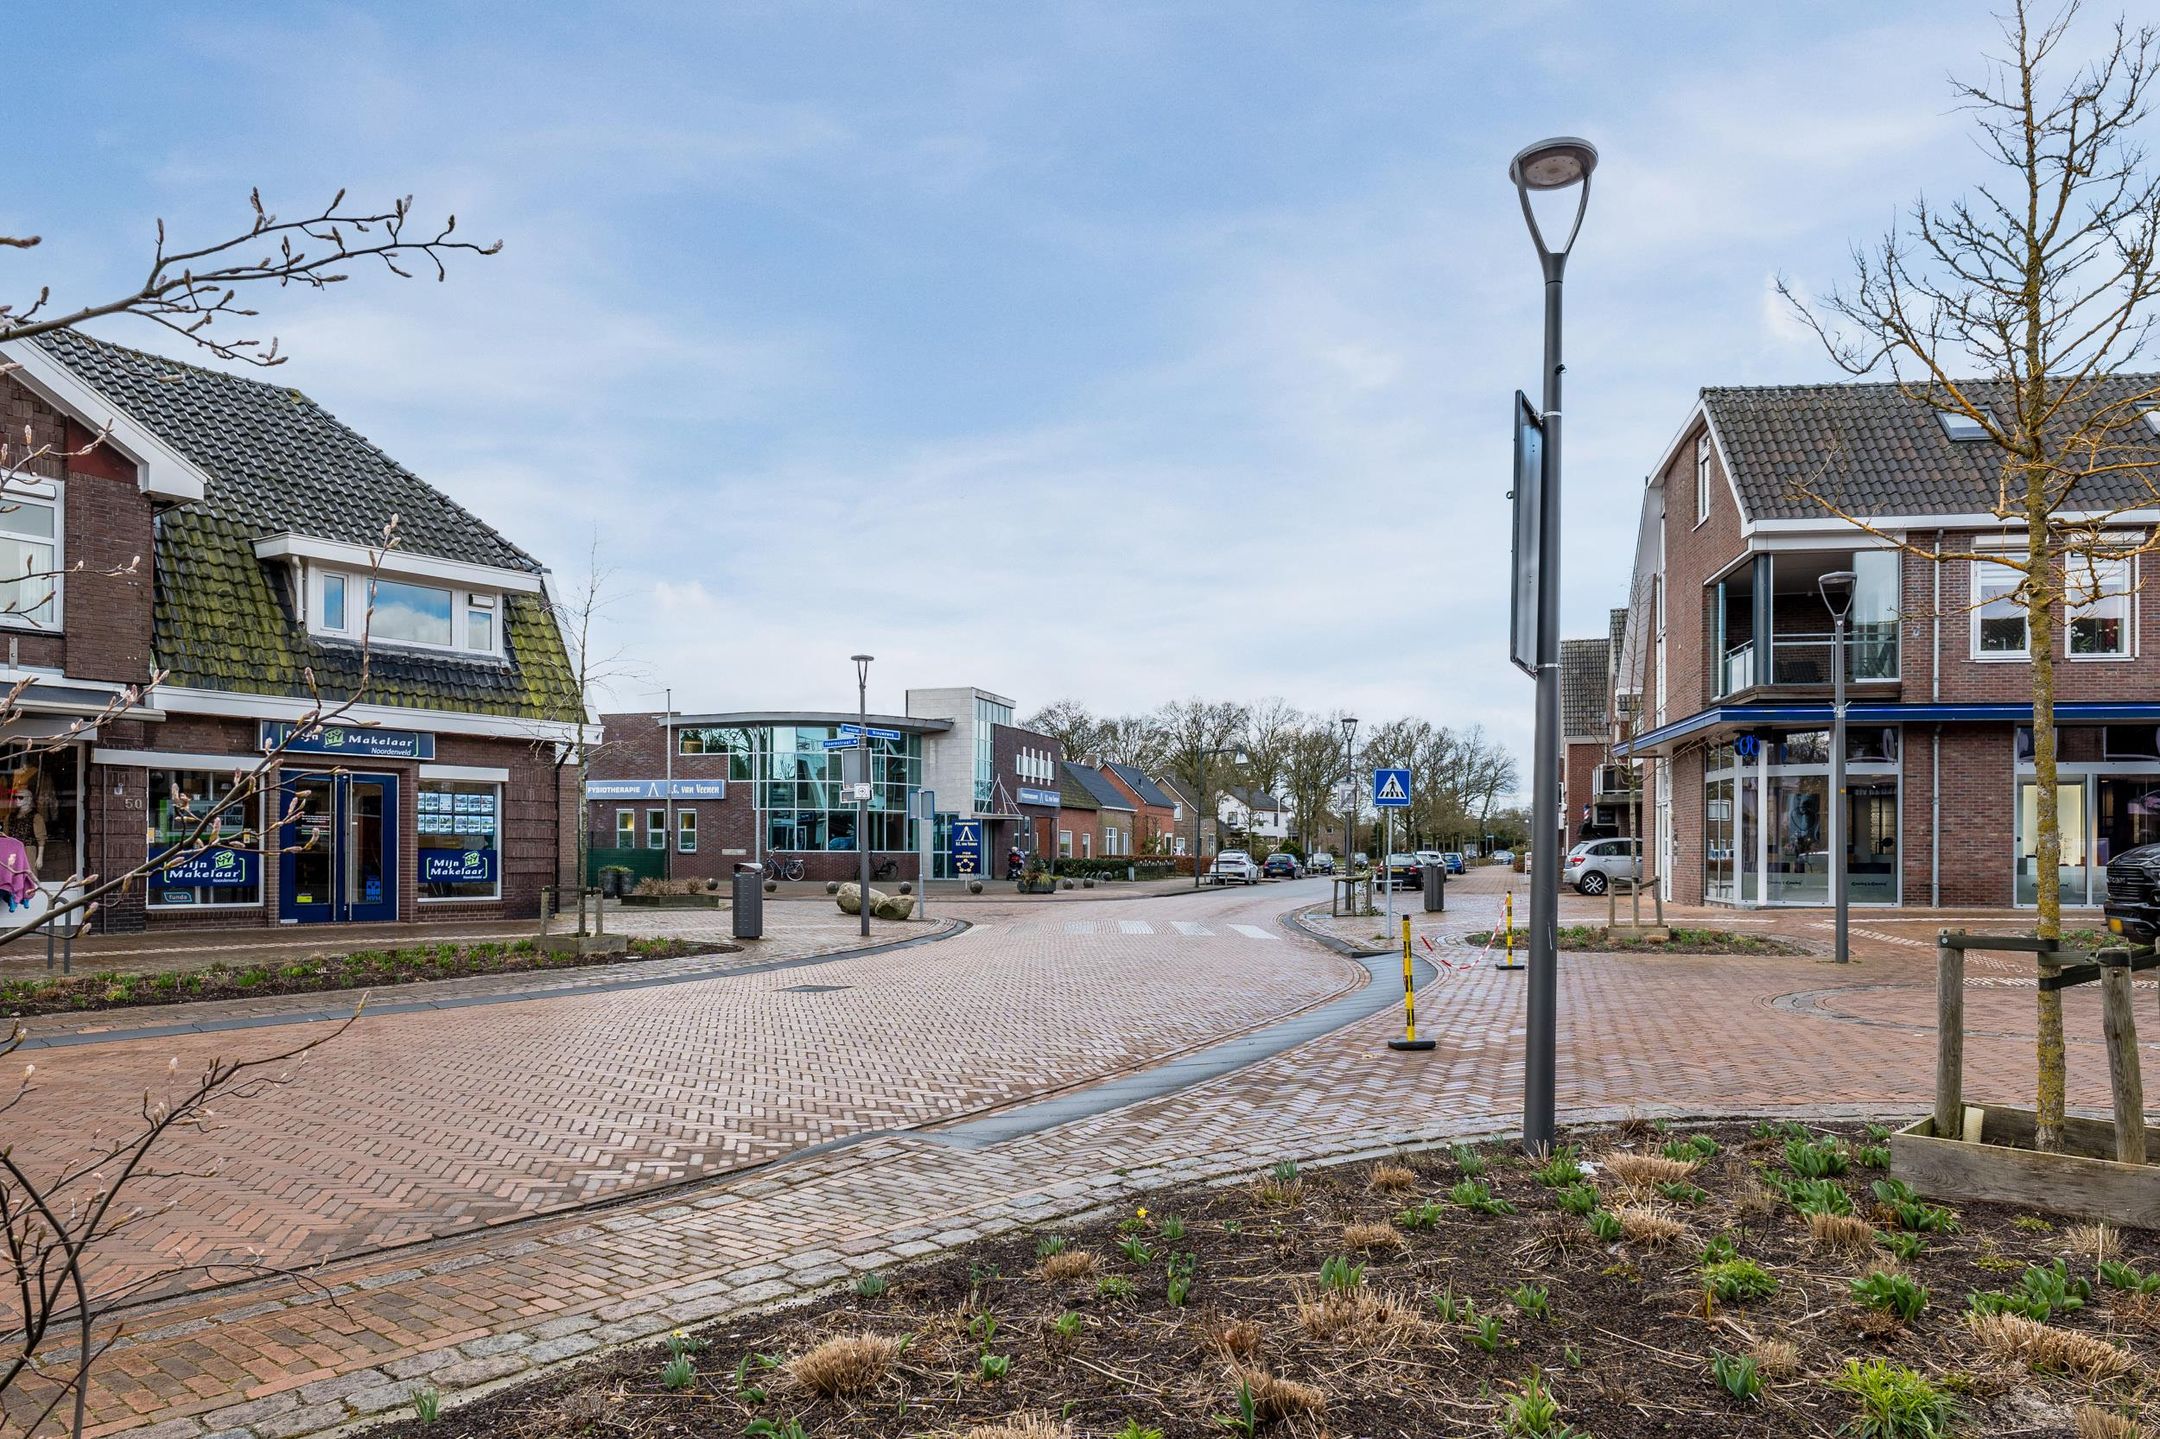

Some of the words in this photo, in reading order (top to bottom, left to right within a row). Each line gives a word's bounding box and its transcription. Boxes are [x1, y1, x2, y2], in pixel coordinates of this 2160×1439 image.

[286, 730, 319, 742] Mjn
[348, 735, 413, 746] Makelaar
[371, 747, 411, 756] Noordenveld
[587, 786, 640, 794] FYSIOTHERAPIE
[681, 786, 694, 794] van
[124, 798, 143, 809] 50
[175, 860, 207, 871] ijn
[434, 859, 459, 868] Mijn
[169, 869, 239, 878] Makelaar
[430, 867, 483, 876] Makelaar
